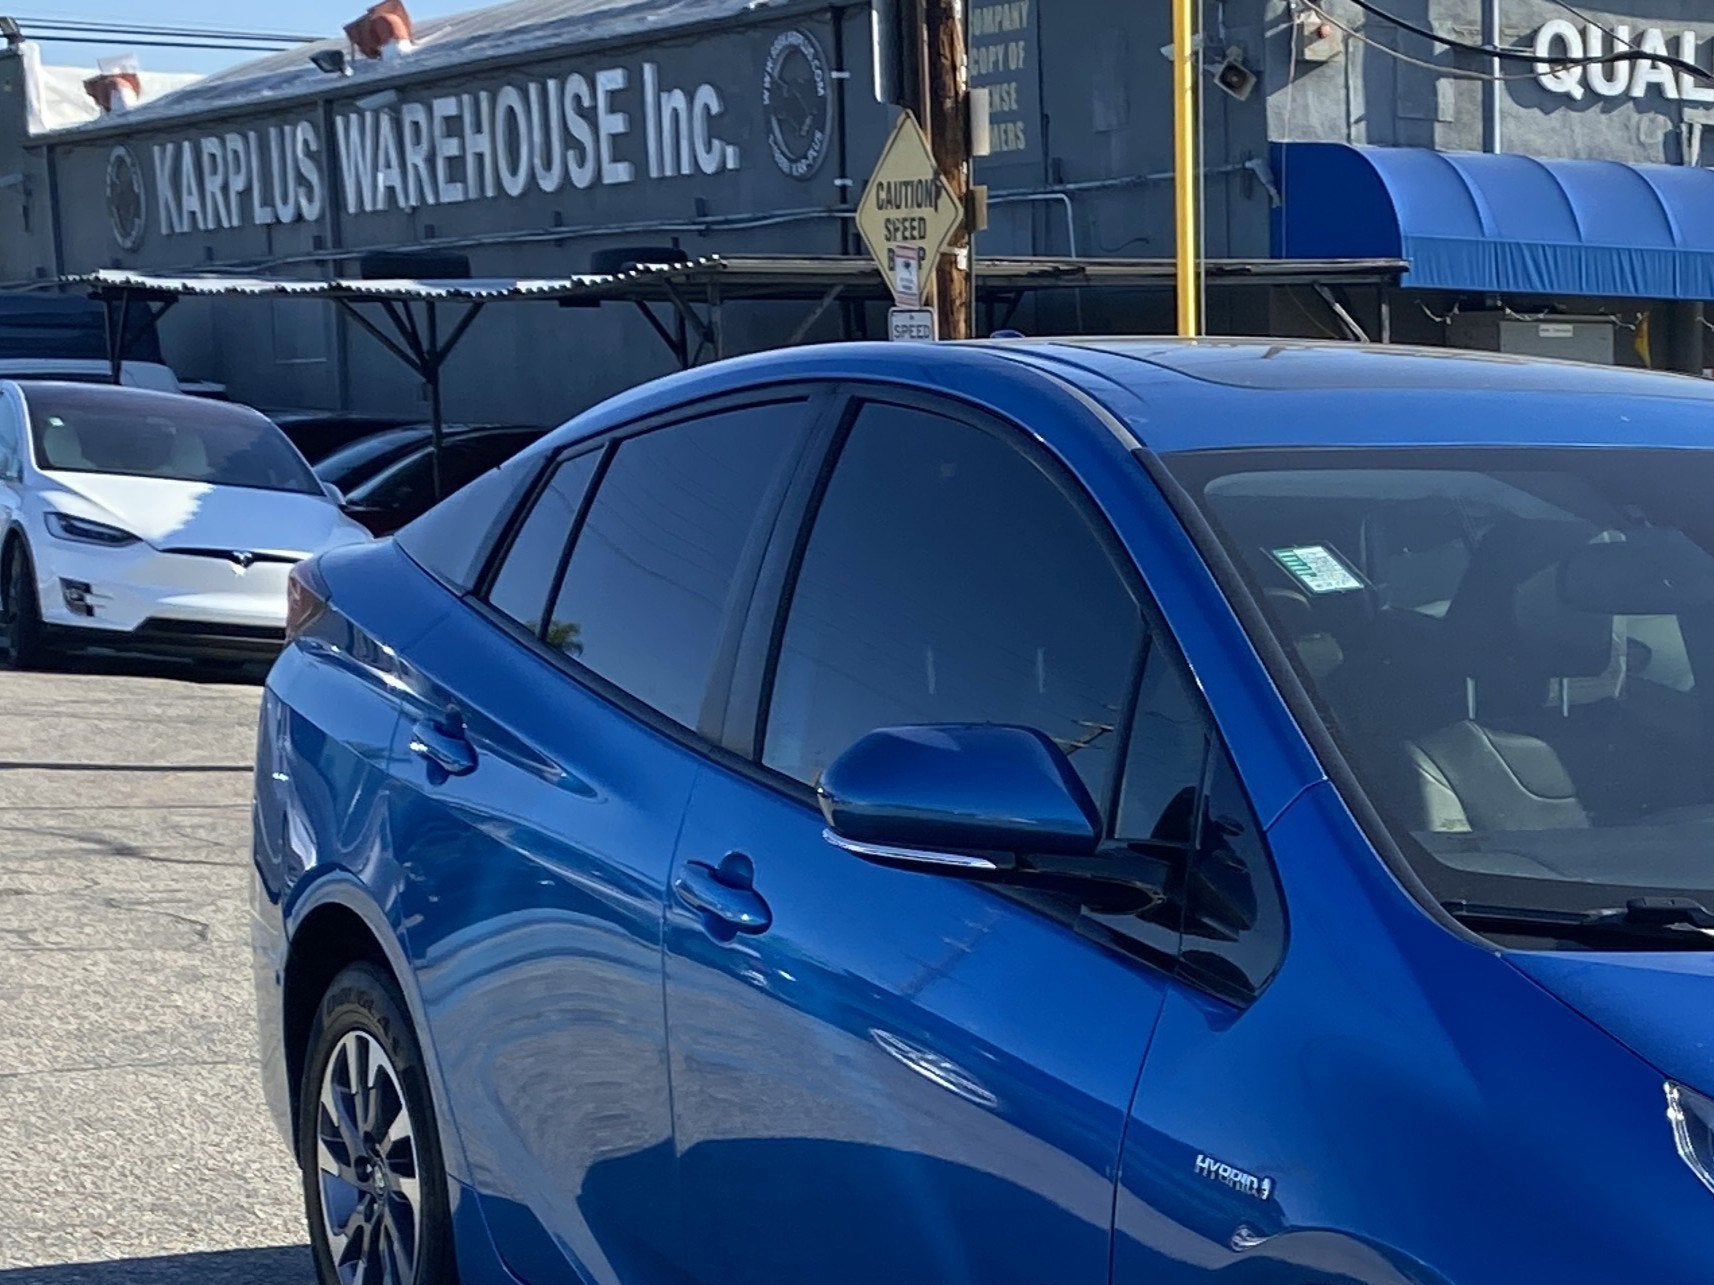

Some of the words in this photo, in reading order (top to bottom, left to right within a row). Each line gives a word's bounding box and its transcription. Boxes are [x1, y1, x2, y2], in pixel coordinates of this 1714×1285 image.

[970, 0, 1029, 36] OMPANY
[153, 120, 323, 235] KARPLUS
[336, 72, 635, 214] WAREHOUSE
[642, 63, 740, 178] Inc.
[884, 216, 926, 242] SPEED
[887, 246, 926, 272] BP
[893, 323, 930, 339] SPEED
